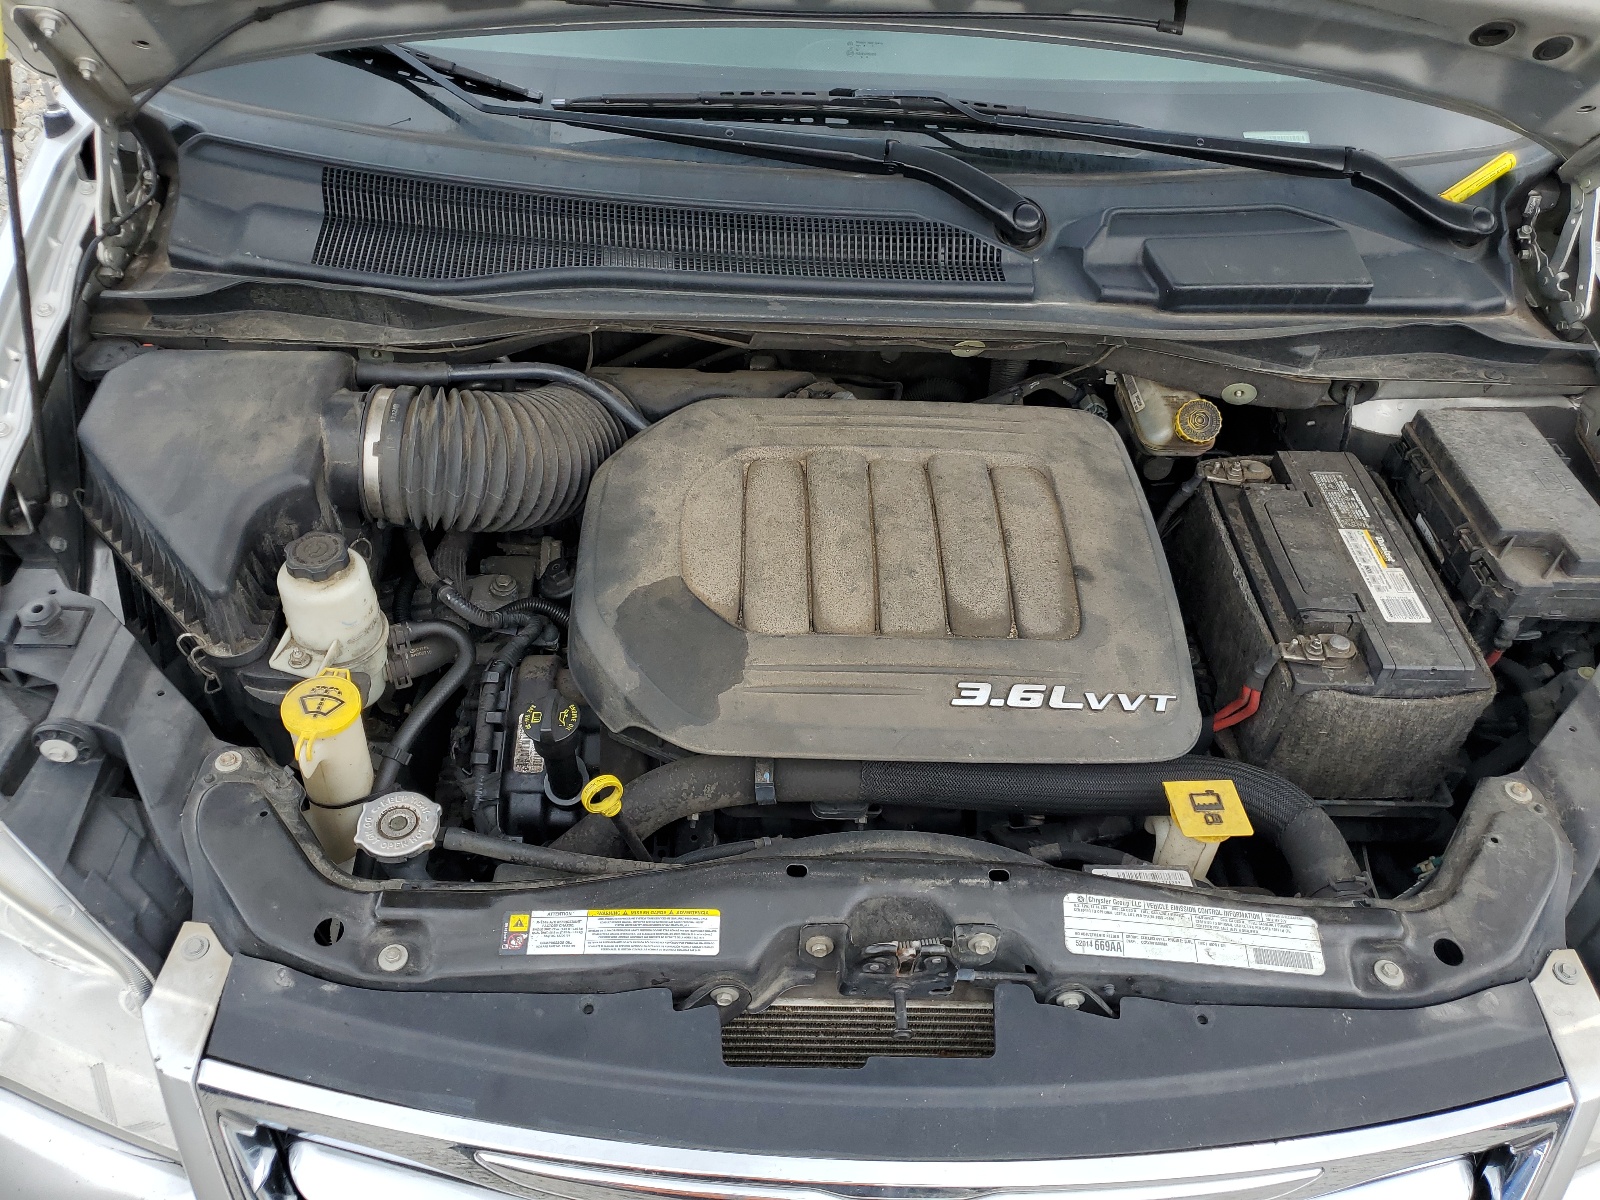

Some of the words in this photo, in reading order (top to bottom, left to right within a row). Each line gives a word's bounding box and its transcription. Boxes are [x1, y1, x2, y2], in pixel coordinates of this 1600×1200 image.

[380, 840, 409, 850] OPEN
[1088, 895, 1112, 905] Chrysler
[1112, 898, 1130, 907] Group
[1131, 900, 1142, 908] LLC
[1146, 902, 1170, 911] VEHICLE
[1170, 904, 1197, 913] EMISSION
[1197, 907, 1223, 916] CONTROL
[1223, 910, 1261, 920] INFORMATION
[1075, 939, 1093, 948] 52014
[1094, 940, 1123, 952] 669AA
